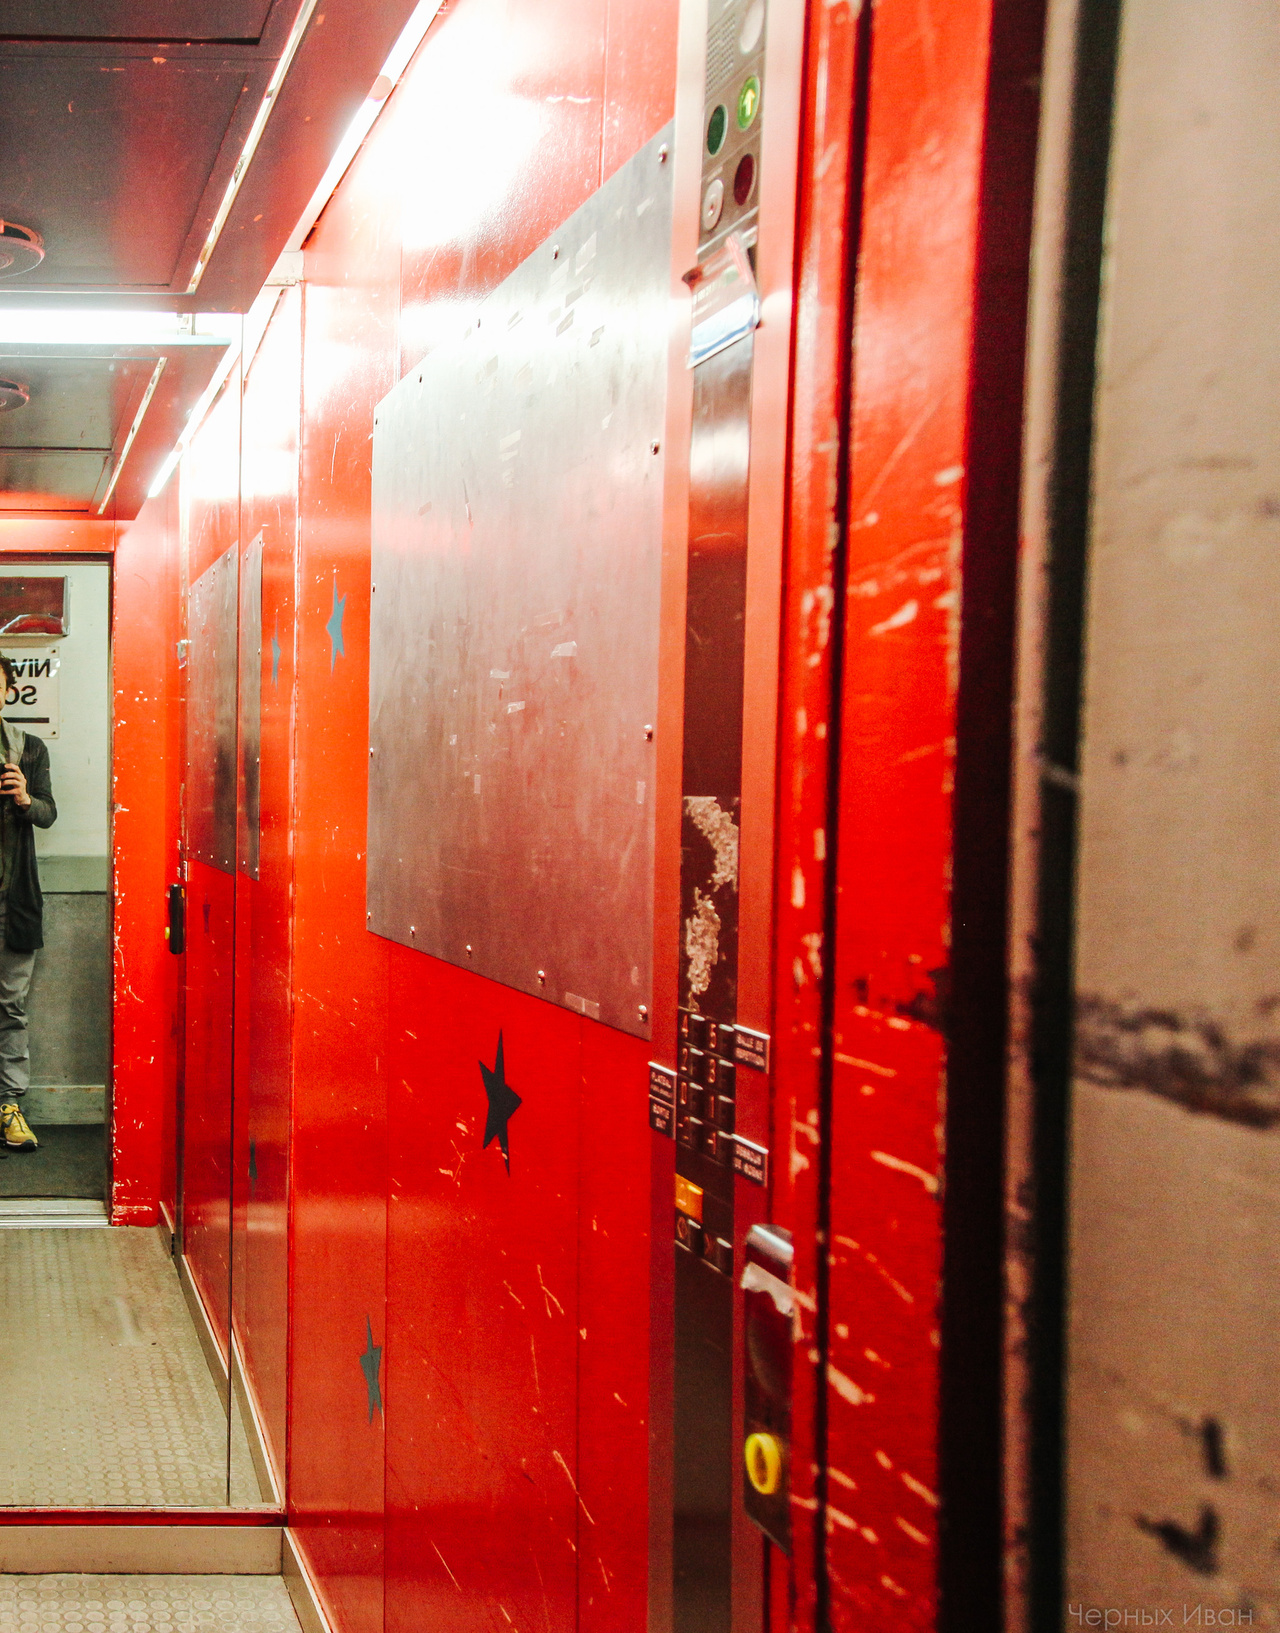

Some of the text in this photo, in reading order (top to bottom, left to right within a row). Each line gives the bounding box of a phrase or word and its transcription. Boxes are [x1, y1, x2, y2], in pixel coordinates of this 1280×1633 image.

[681, 1014, 689, 1038] 4
[709, 1023, 717, 1049] 5
[680, 1047, 688, 1071] 2
[707, 1058, 716, 1083] 3
[710, 1096, 715, 1118] 1
